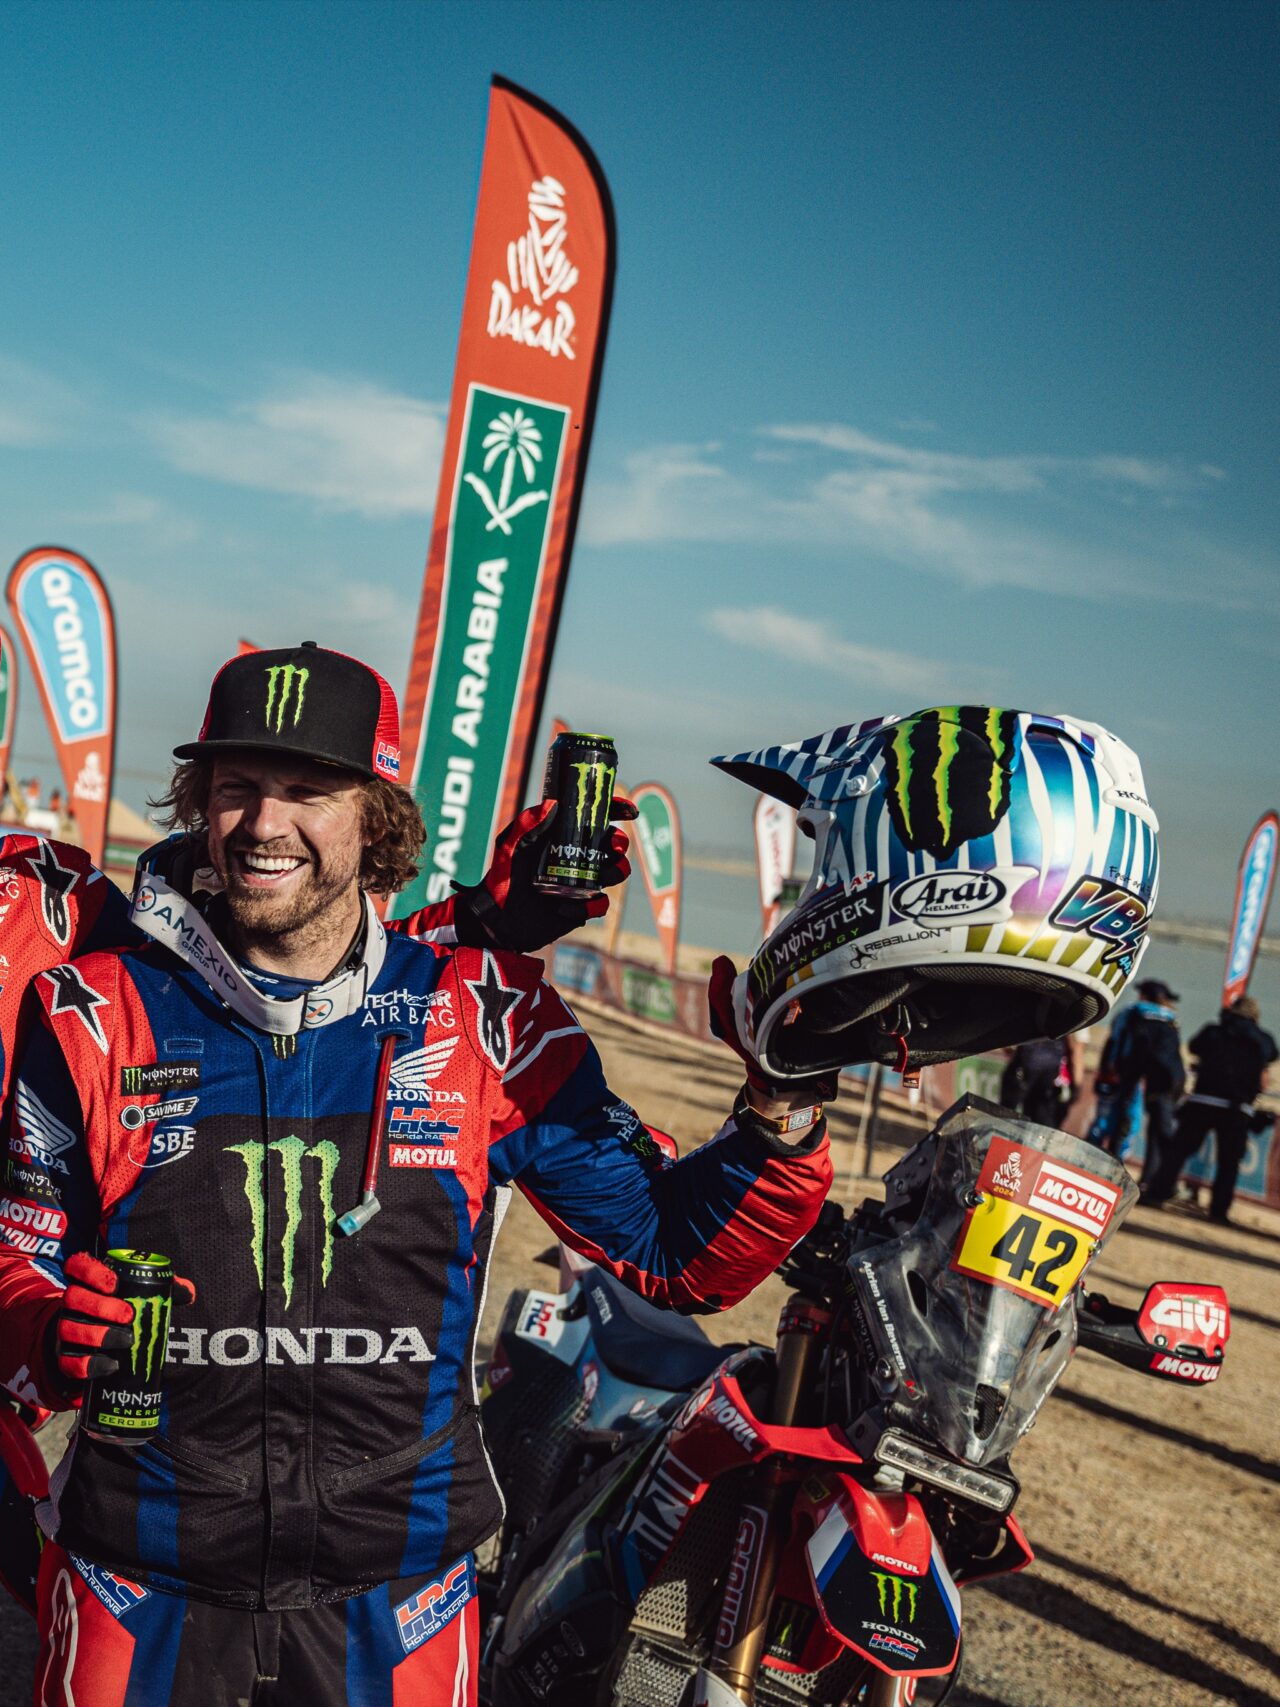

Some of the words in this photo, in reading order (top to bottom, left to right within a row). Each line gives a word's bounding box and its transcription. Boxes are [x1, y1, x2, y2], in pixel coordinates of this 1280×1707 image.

[486, 278, 576, 360] DAKAR
[41, 567, 98, 729] aramco
[426, 756, 474, 902] SAUDI
[451, 558, 509, 748] ARABIA
[547, 866, 581, 878] ZERO
[901, 875, 992, 912] Arai
[924, 903, 967, 912] HELMET
[154, 905, 237, 992] AMEXIO
[774, 897, 875, 965] MONSTER
[788, 928, 860, 971] ENERGY
[864, 929, 942, 952] REBELLION
[181, 939, 210, 970] GROUP
[142, 1067, 199, 1081] MONSTER
[386, 1089, 467, 1103] HONDA
[388, 1106, 466, 1135] HRC
[152, 1130, 197, 1154] SBE
[392, 1147, 458, 1167] MOTUL
[991, 1173, 1022, 1193] DAKAR
[992, 1185, 1015, 1198] 2024
[1038, 1178, 1108, 1222] MOTUL
[0, 1197, 62, 1235] MOTUL
[990, 1213, 1078, 1297] 42
[862, 1260, 881, 1298] Adrien
[876, 1299, 890, 1322] Van
[884, 1323, 907, 1371] Beveren
[1150, 1298, 1227, 1339] GIVI
[165, 1327, 436, 1366] HONDA
[1157, 1357, 1219, 1381] MOTUL
[100, 1416, 136, 1427] ZERO
[708, 1395, 758, 1453] MOTUL
[872, 1552, 920, 1575] MOTUL
[88, 1577, 121, 1615] RACING
[396, 1560, 469, 1644] HRC
[405, 1621, 442, 1649] Honda
[441, 1591, 470, 1623] RACING
[861, 1620, 927, 1649] HONDA
[870, 1633, 919, 1659] HRC
